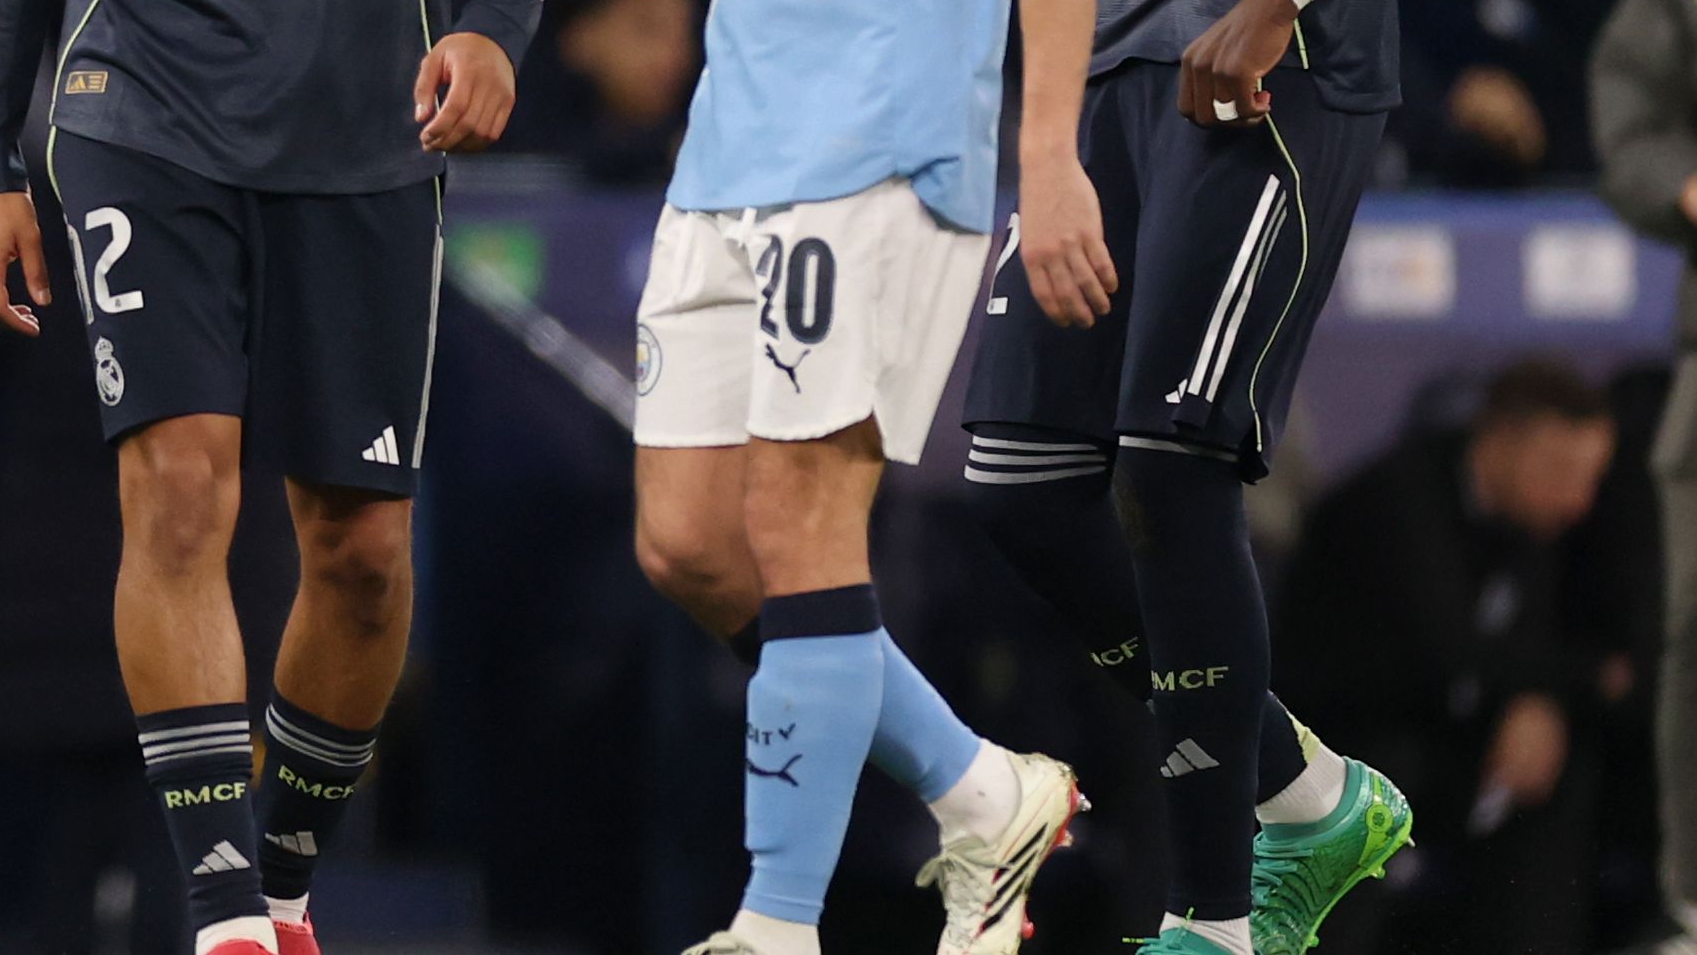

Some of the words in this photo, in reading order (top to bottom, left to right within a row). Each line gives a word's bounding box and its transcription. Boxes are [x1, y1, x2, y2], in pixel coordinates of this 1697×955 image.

[755, 234, 836, 344] 20
[1151, 666, 1229, 691] MCF
[165, 782, 247, 809] RMCF
[278, 764, 354, 800] RMCF
